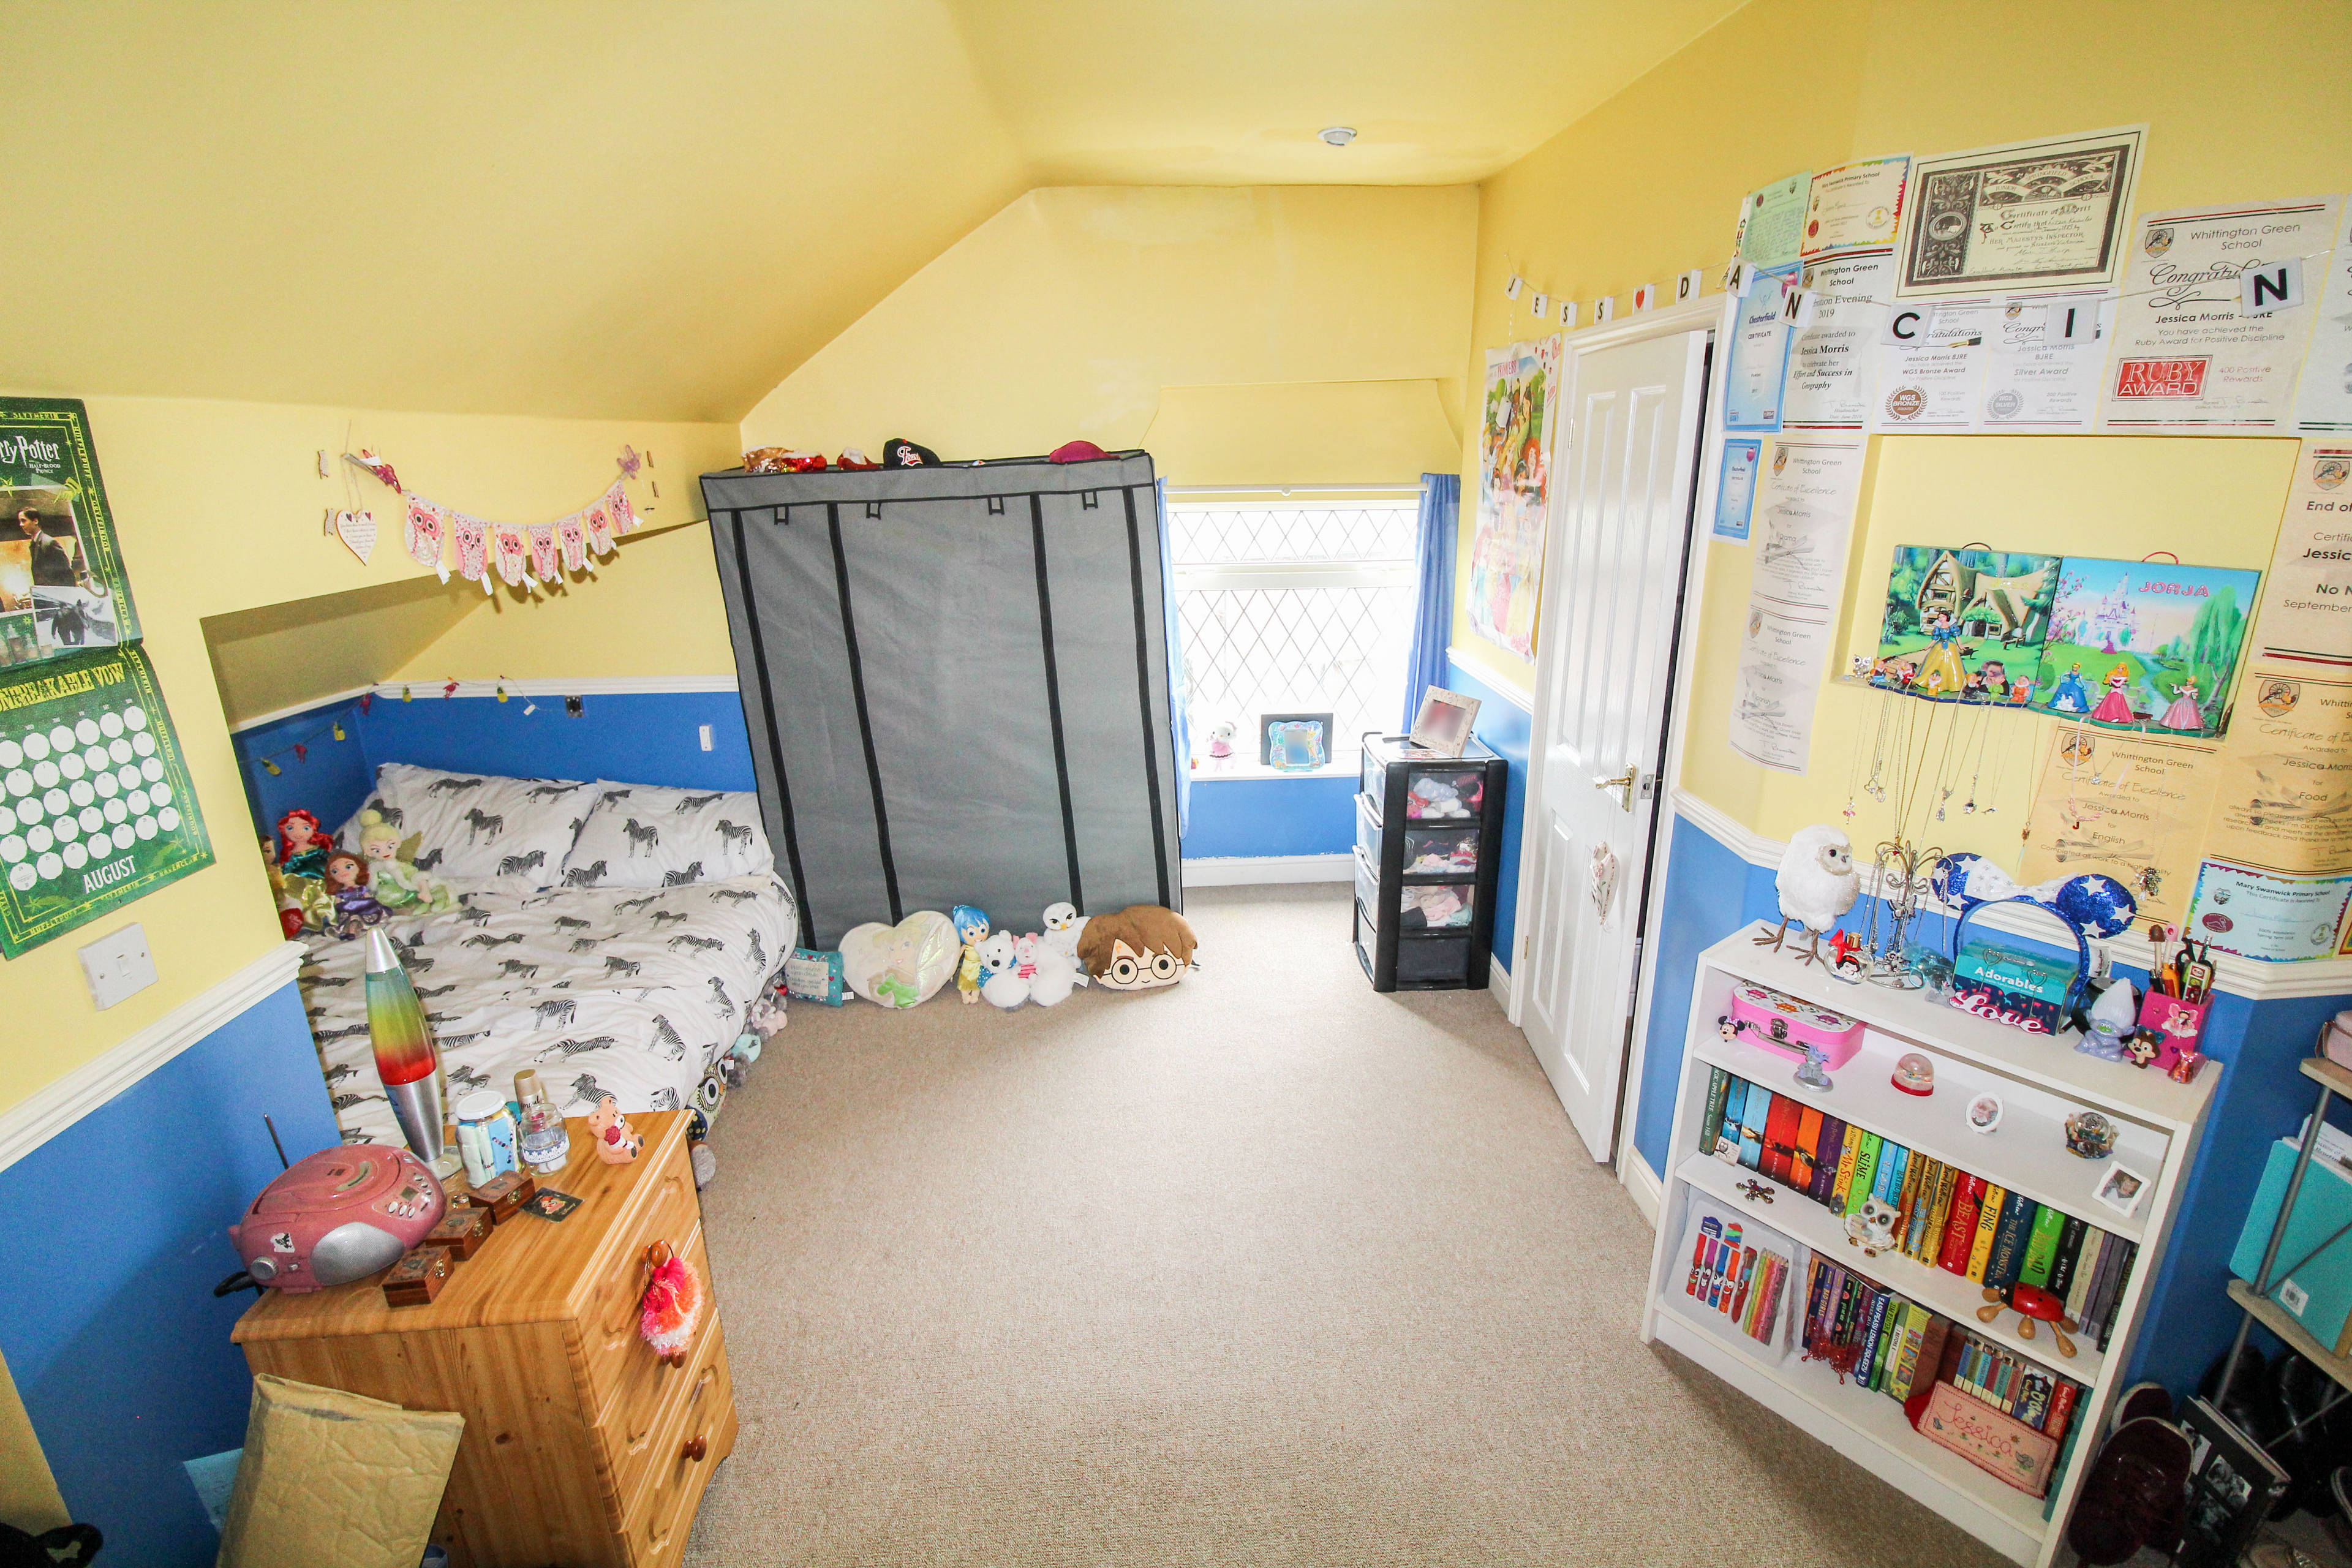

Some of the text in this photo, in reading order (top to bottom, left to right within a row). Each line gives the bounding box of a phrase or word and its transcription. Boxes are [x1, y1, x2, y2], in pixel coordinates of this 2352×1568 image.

[2191, 225, 2300, 239] Whittington Green
[2221, 239, 2262, 251] School
[1830, 278, 1854, 287] School
[2254, 268, 2288, 306] N
[1785, 292, 1802, 319] N
[1834, 294, 1872, 304] Evening
[1749, 311, 1776, 325] Chesterfield
[1819, 309, 1834, 318] 2019
[2155, 312, 2234, 324] Jessica Morris
[1893, 312, 1920, 339] C
[1747, 331, 1771, 339] CERTIFICATE
[2241, 334, 2285, 344] Discipline
[1819, 344, 1849, 354] Morris
[1793, 371, 1806, 380] Effort
[2126, 361, 2204, 383] RUBY
[1802, 381, 1831, 391] Geography
[2119, 383, 2198, 396] AWARD
[15, 435, 61, 467] Potter
[2307, 501, 2334, 511] End
[2138, 581, 2211, 598] JORJA
[2316, 584, 2339, 595] No
[2283, 598, 2352, 613] September
[91, 662, 126, 687] VOW
[2260, 723, 2339, 744] Certificate of
[2112, 751, 2193, 769] Whittington Green
[2283, 758, 2324, 770] Jessica
[2135, 764, 2166, 775] School
[2132, 783, 2186, 800] Excellence
[2299, 791, 2328, 801] Food
[2121, 810, 2150, 821] Morris
[2092, 832, 2126, 844] English
[83, 854, 137, 894] AUGUST
[2236, 881, 2255, 890] Mary
[2255, 886, 2291, 897] Swanwick
[2259, 894, 2290, 903] Certificate
[1974, 967, 2044, 993] Adorables
[1950, 990, 2050, 1034] Love
[1856, 1150, 1871, 1180] SLIME
[1836, 1154, 1853, 1193] Mr Stink
[1951, 1199, 1973, 1243] BEAST
[1980, 1205, 1997, 1232] FING
[1995, 1247, 2011, 1280] MONSTER
[1937, 1400, 2013, 1458] Jessica
